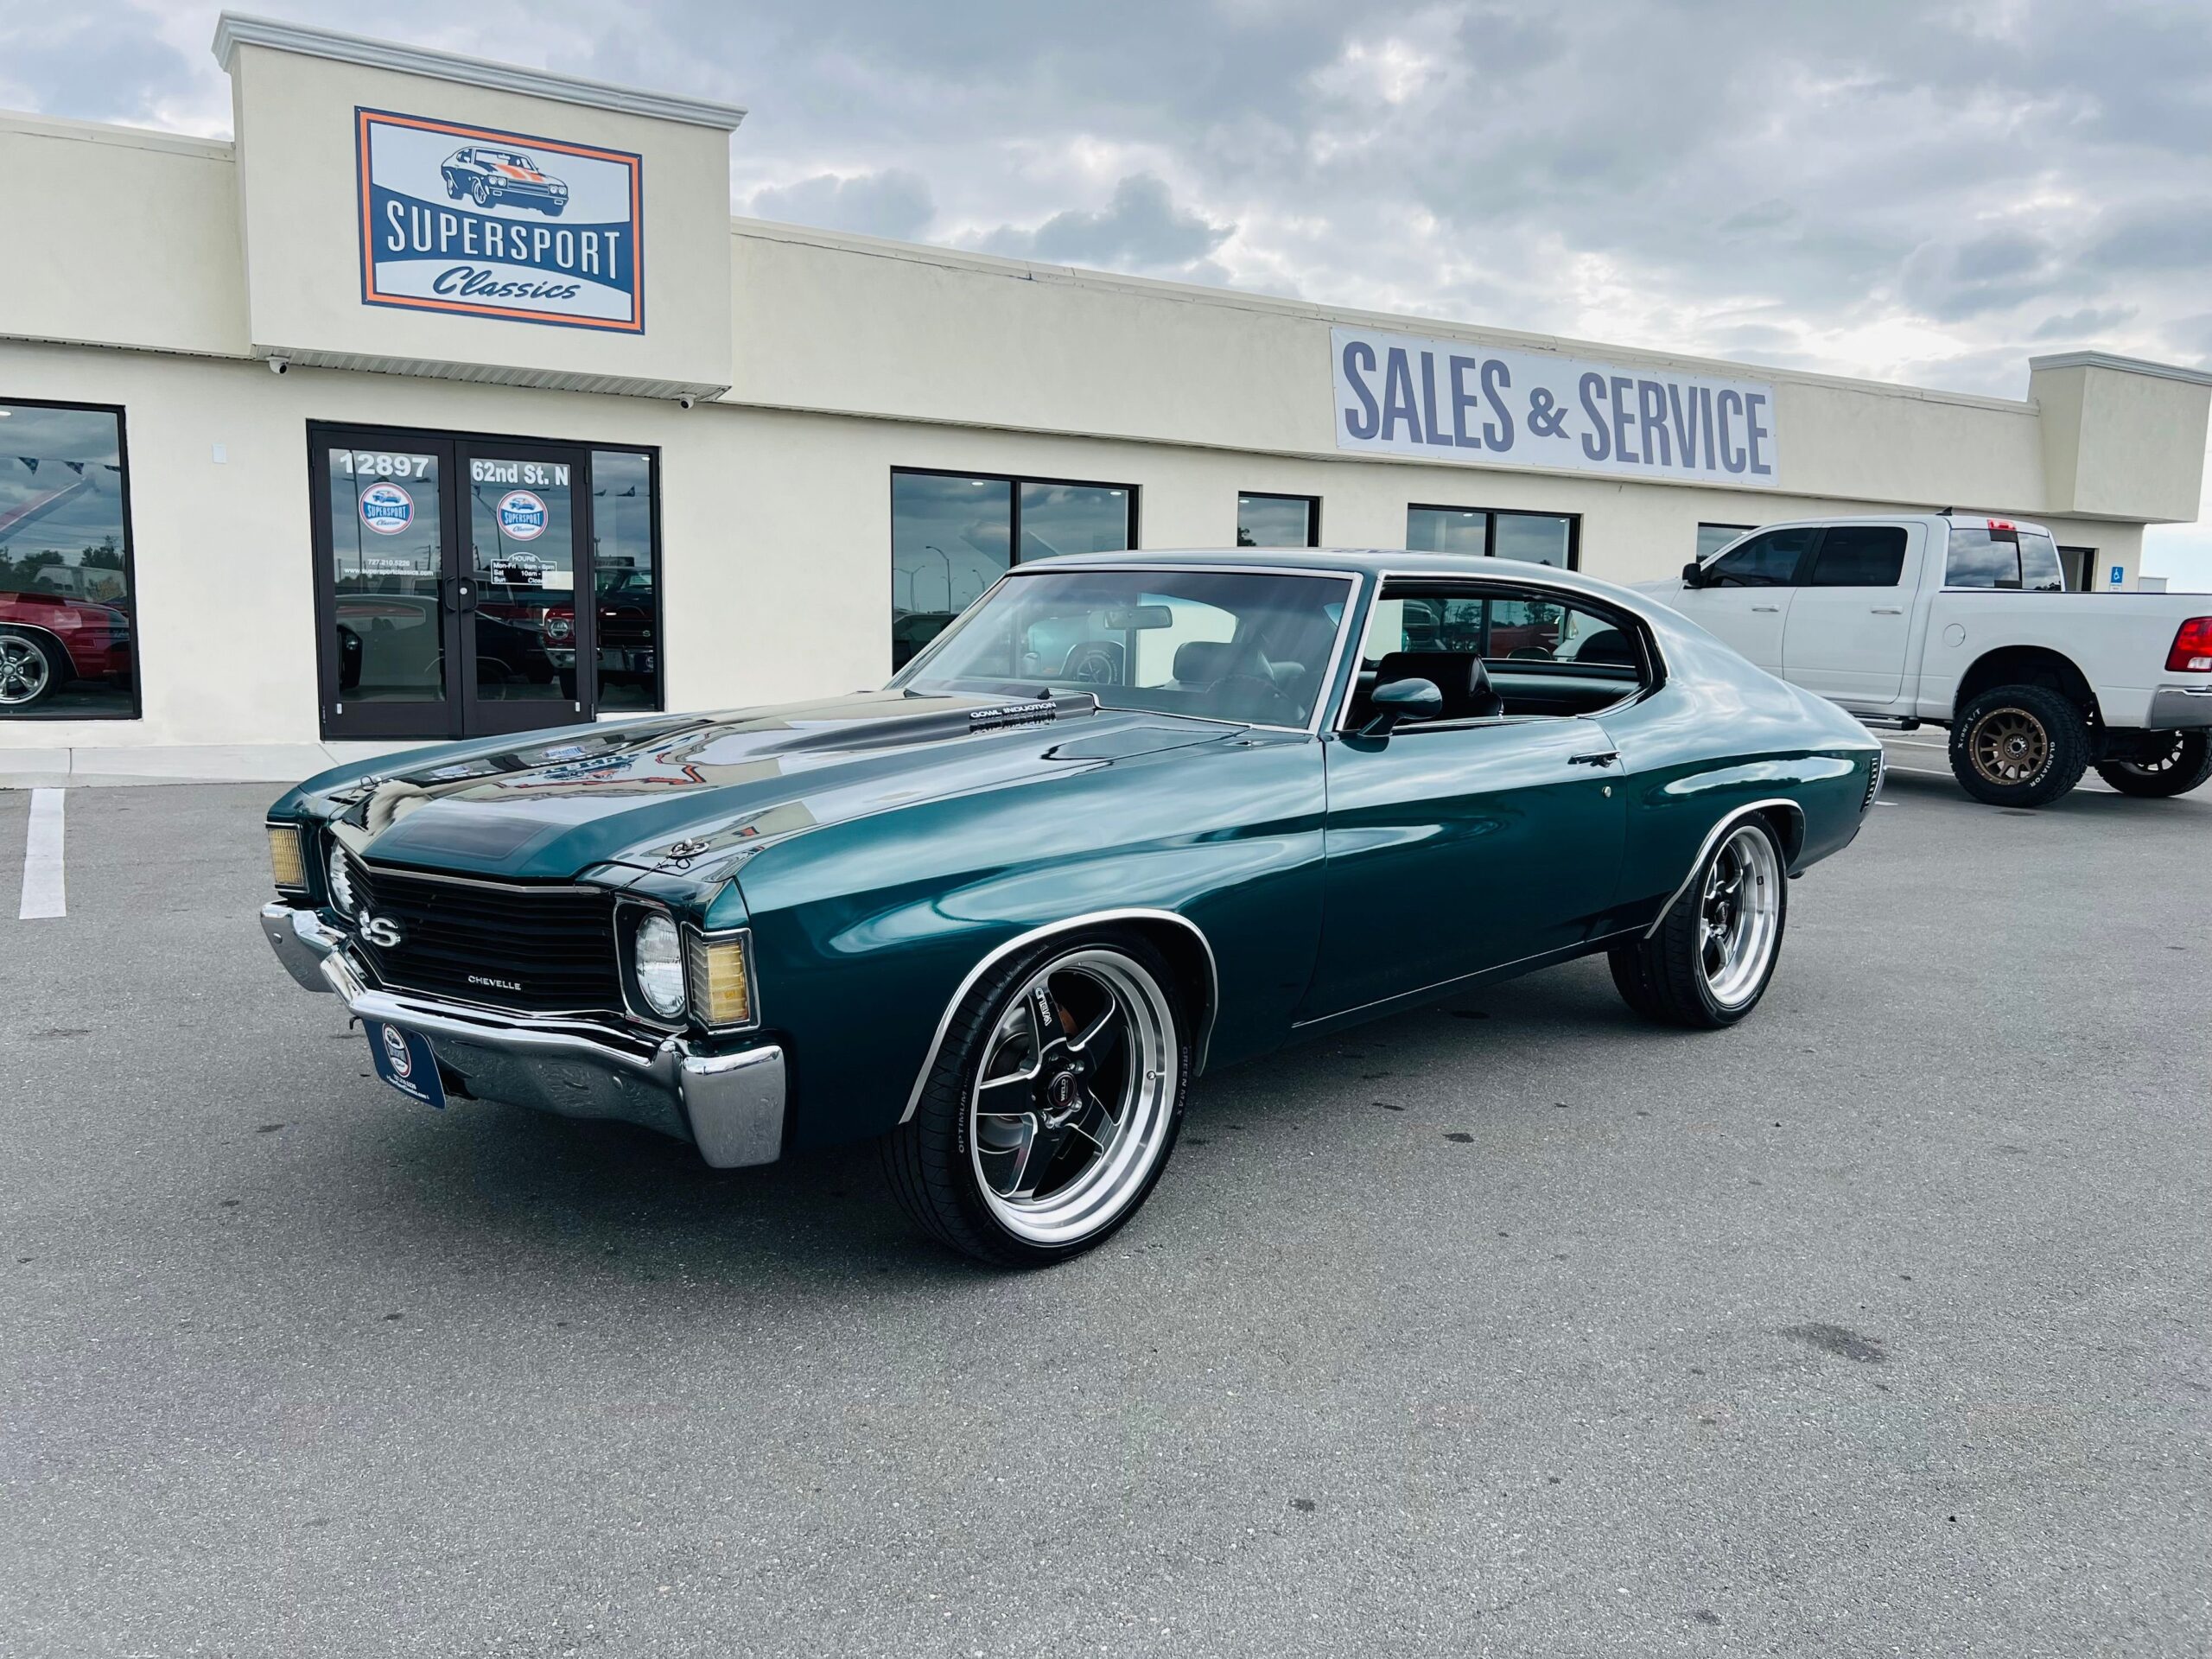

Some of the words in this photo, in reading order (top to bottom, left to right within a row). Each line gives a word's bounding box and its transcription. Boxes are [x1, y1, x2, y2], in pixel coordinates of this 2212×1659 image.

[387, 200, 620, 279] SUPERSPORT
[433, 266, 582, 299] Classics
[1343, 341, 1515, 453] SALES
[1527, 387, 1571, 438] &
[1579, 372, 1772, 474] SERVICE
[340, 453, 429, 477] 12897
[472, 461, 518, 483] 62nd
[524, 465, 550, 485] St.
[555, 467, 569, 486] N
[367, 505, 406, 519] SUPERSPORT
[505, 512, 541, 525] SUPERSPORT
[970, 709, 1002, 718] COWL
[1002, 702, 1057, 714] INDUCTION
[2029, 741, 2056, 787] GLADIATOR
[467, 975, 522, 991] CHEVELLE
[1035, 987, 1052, 1027] WELD
[957, 1090, 969, 1154] OPTIMUM
